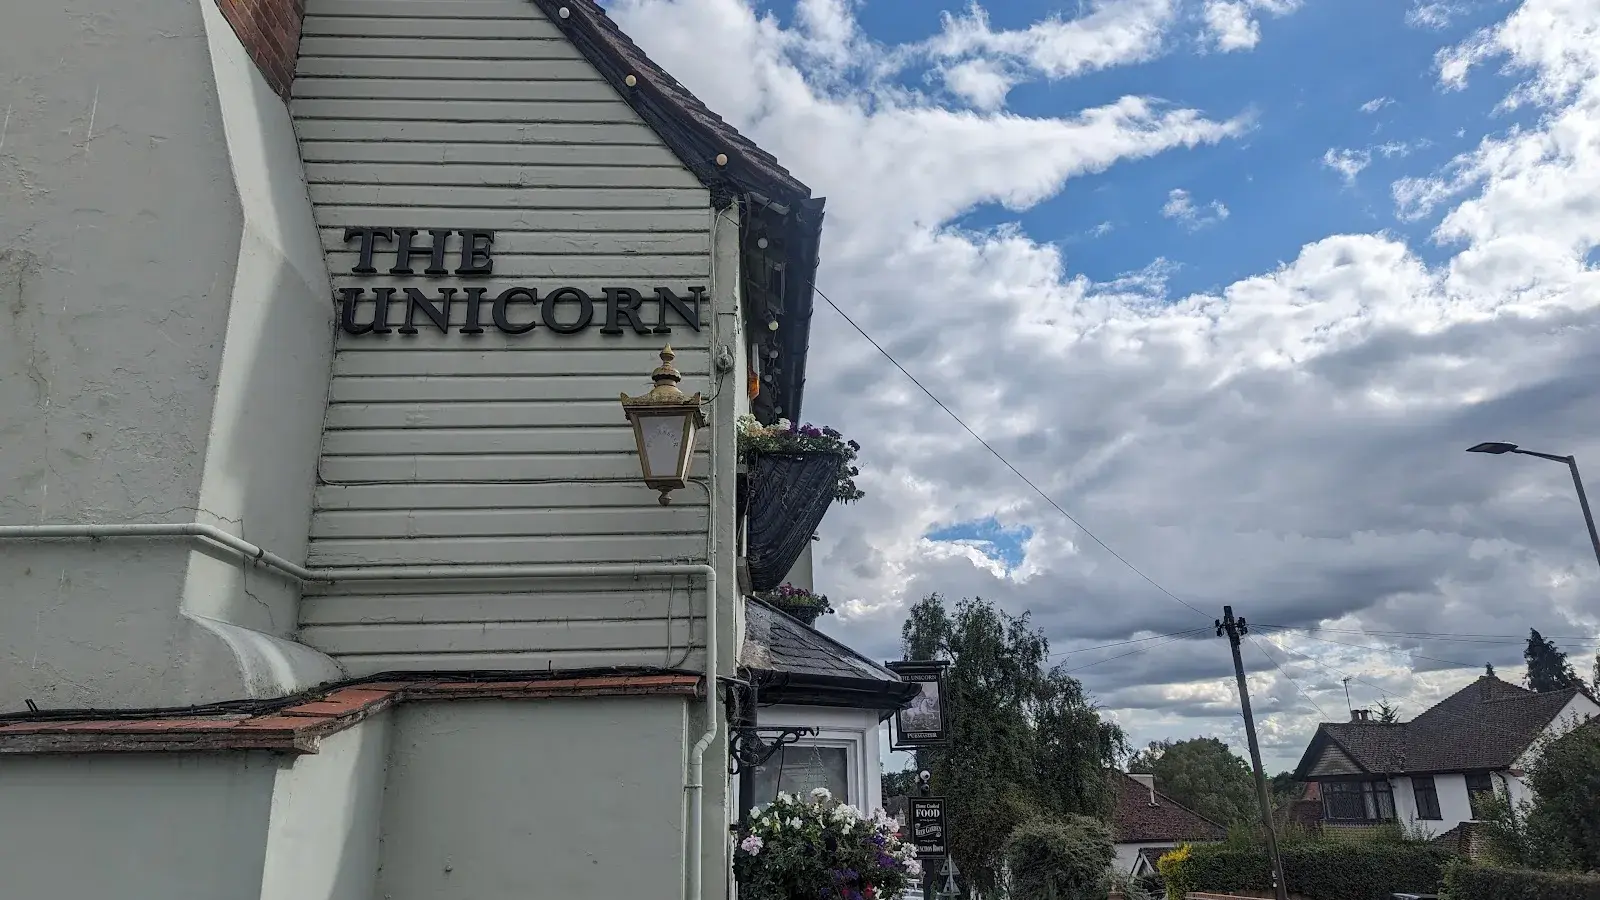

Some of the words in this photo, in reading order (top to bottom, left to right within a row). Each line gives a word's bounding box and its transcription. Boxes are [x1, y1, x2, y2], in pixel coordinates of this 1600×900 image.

[344, 227, 495, 275] THE
[339, 286, 705, 335] UNICORN
[915, 809, 940, 818] FOOD
